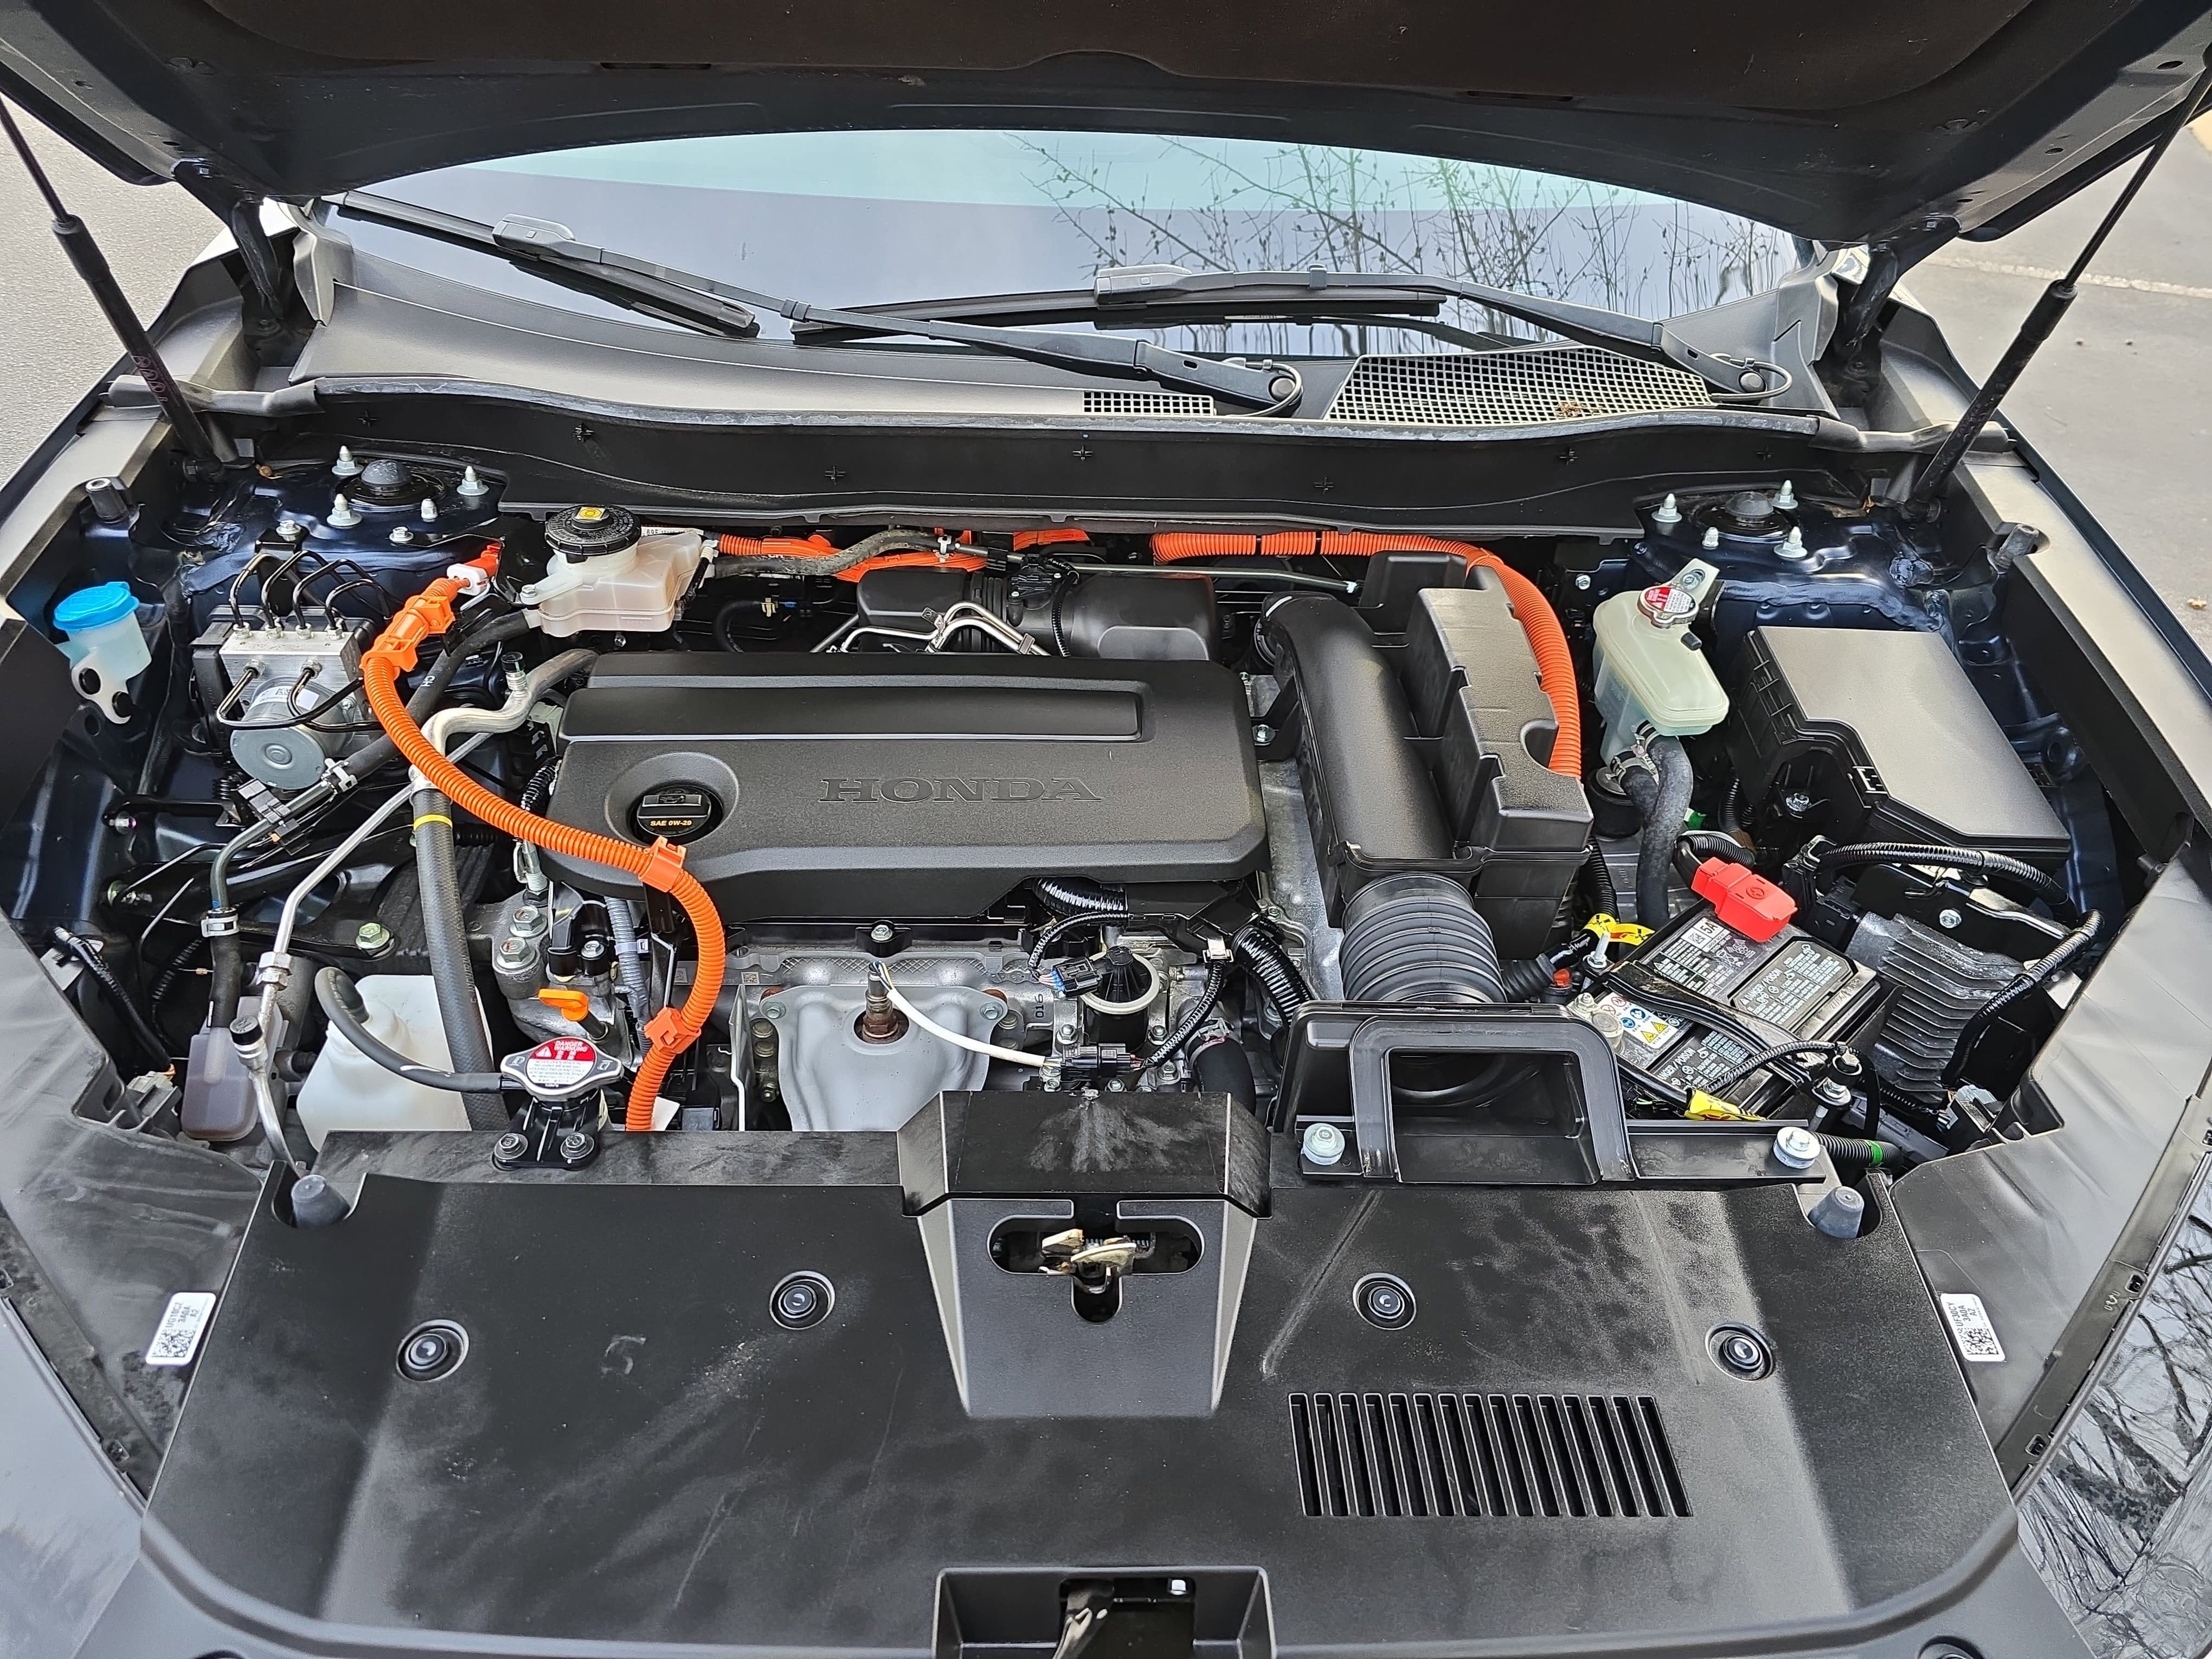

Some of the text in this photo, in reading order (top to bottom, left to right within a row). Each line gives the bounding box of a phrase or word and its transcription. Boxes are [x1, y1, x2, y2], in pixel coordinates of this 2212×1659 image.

[818, 777, 1102, 803] HONDA
[1700, 922, 1718, 934] 5A
[1745, 983, 1764, 1003] DANGER
[1764, 968, 1782, 984] POISON
[1034, 994, 1044, 1018] 016
[1676, 1047, 1696, 1066] POISON
[1946, 1302, 1964, 1327] UF30CY
[1967, 1308, 1977, 1316] A2
